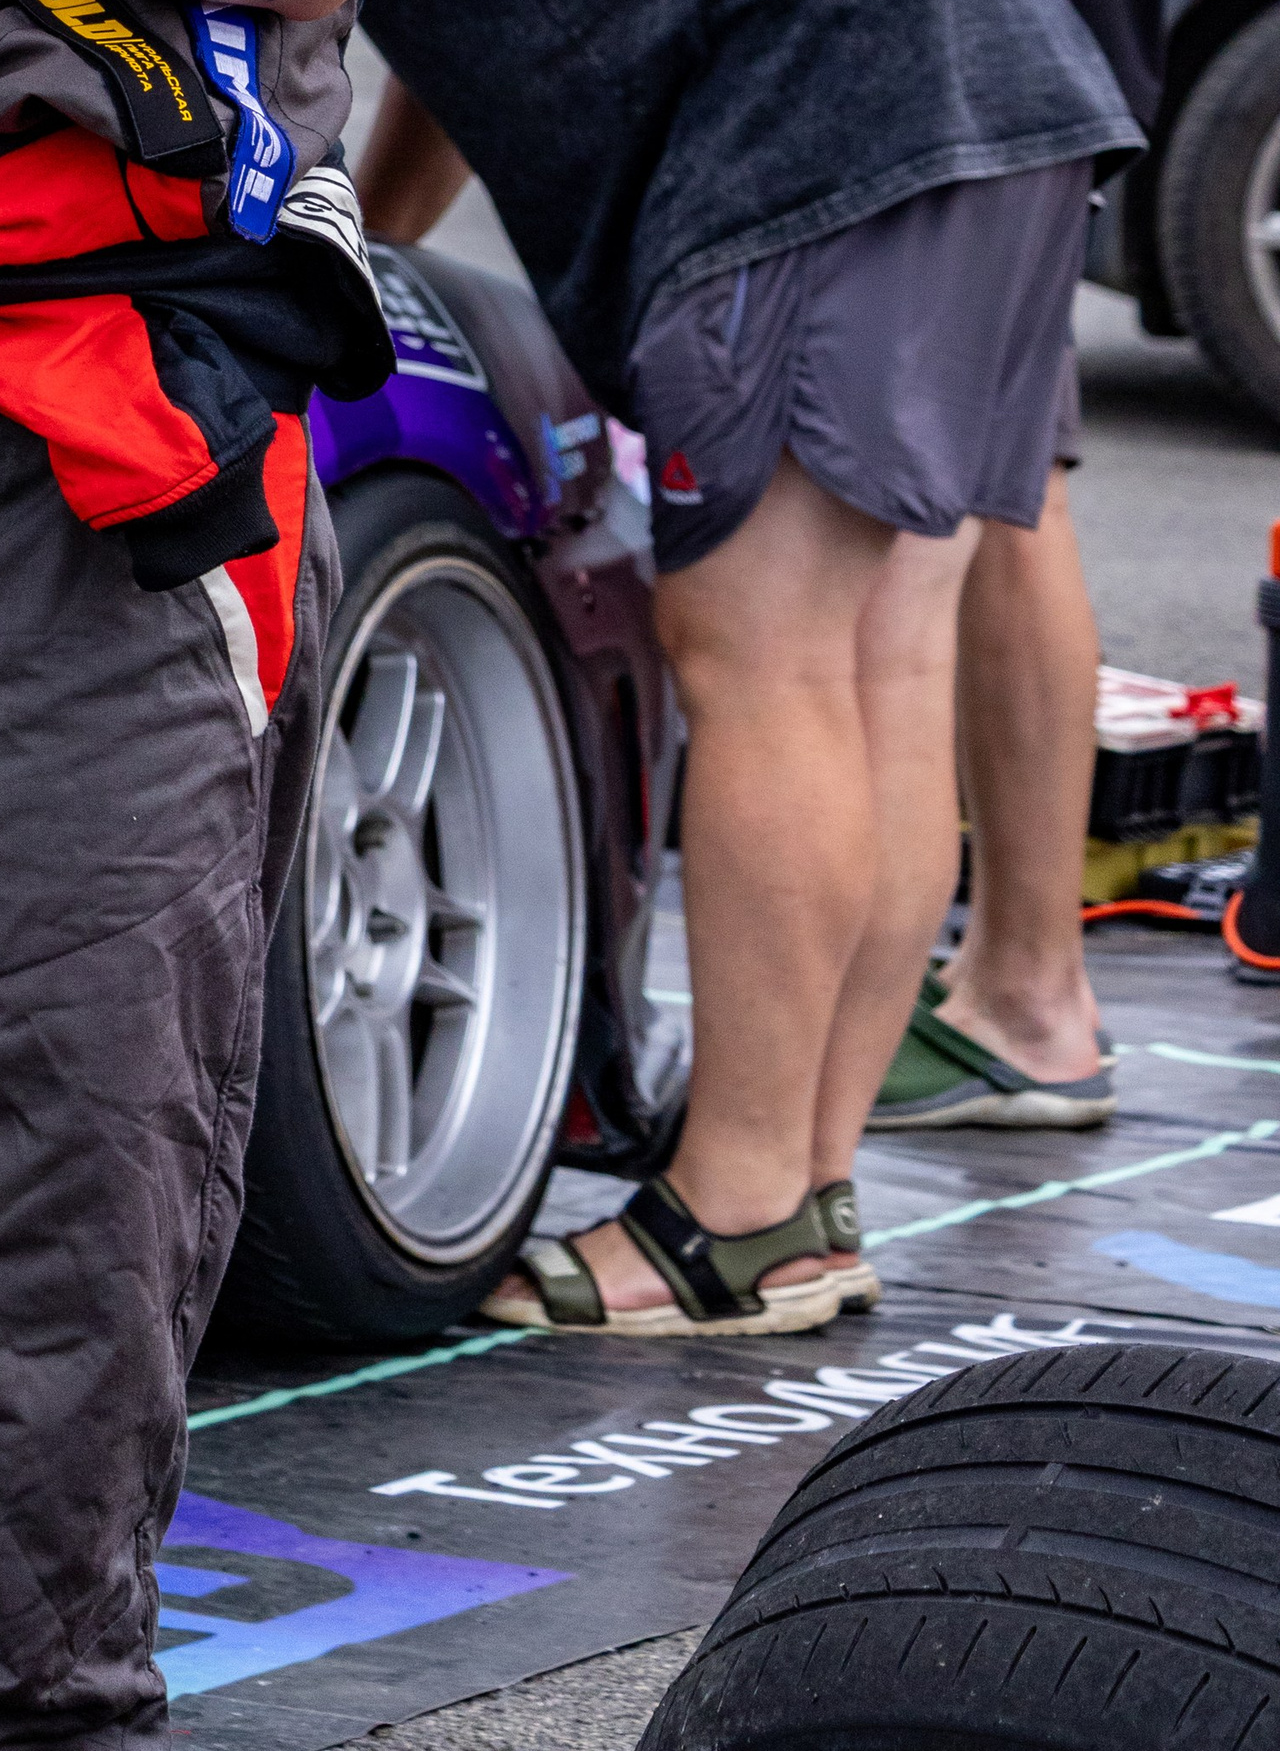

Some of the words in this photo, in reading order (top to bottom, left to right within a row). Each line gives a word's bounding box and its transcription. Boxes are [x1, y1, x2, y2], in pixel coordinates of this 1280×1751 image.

[104, 42, 154, 93] ДРИФТА
[121, 43, 156, 71] ЛИГА
[137, 39, 194, 123] УРАЛЬСКАЯ
